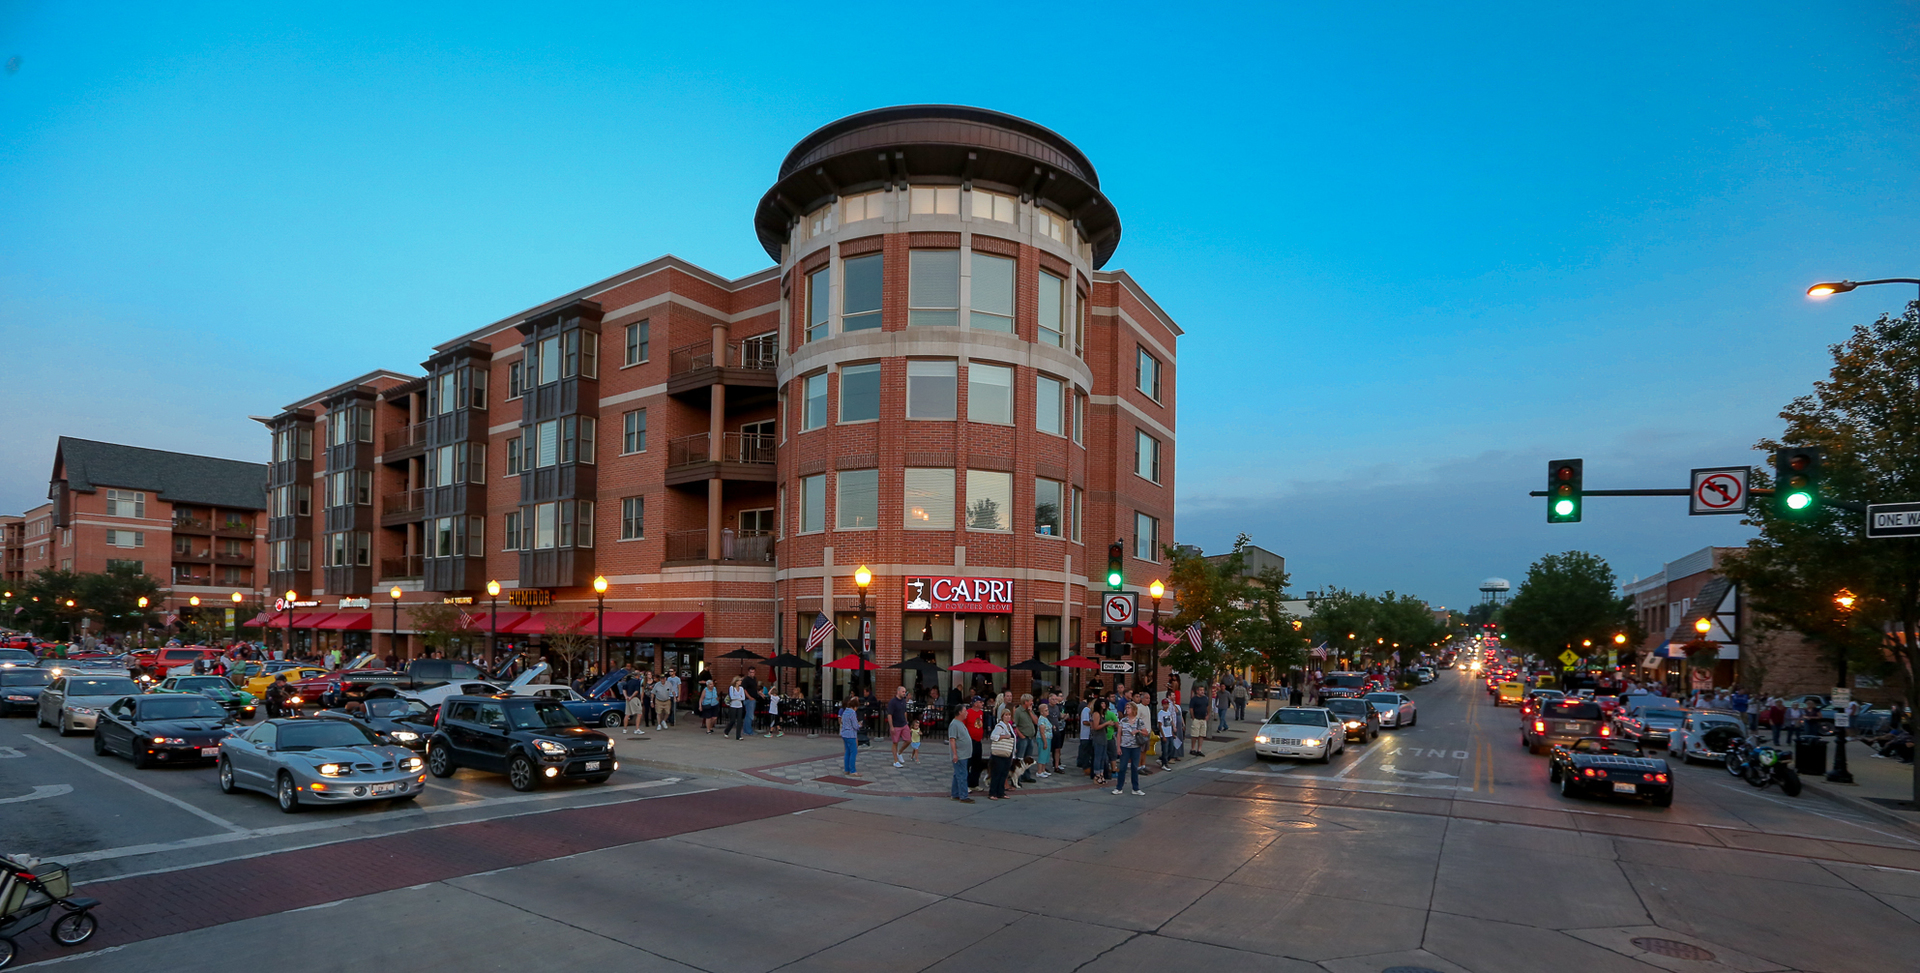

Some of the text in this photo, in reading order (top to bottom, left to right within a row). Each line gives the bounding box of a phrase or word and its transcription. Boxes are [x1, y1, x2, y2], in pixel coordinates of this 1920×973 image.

[1878, 514, 1903, 526] ONE
[509, 590, 550, 605] HUMIDOR
[933, 579, 1013, 603] CAPRI
[1387, 747, 1469, 759] ONLY
